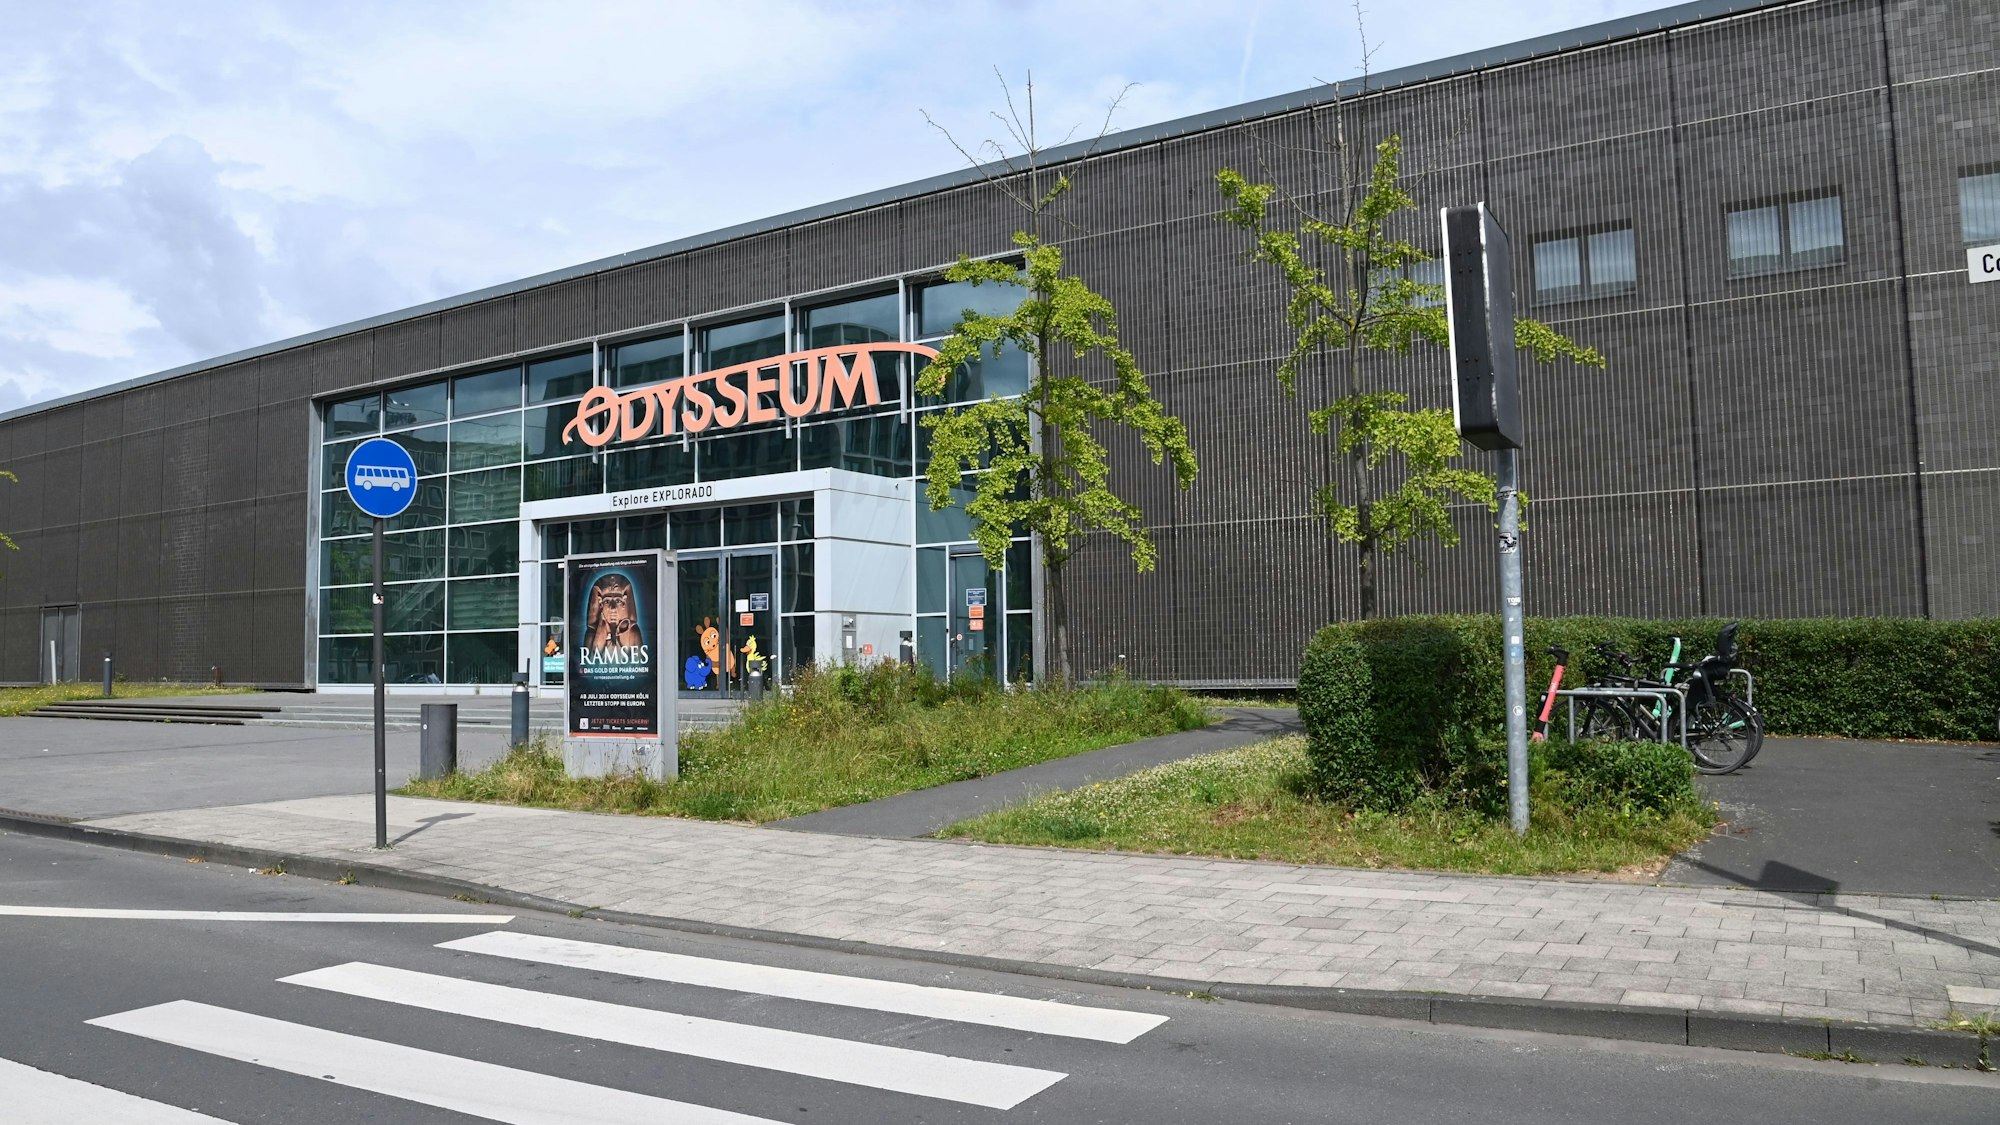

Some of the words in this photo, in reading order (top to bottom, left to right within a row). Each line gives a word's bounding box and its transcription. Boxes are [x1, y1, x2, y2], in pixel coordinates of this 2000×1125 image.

[563, 343, 938, 447] ODYSSEUM
[612, 494, 649, 509] Explore
[652, 485, 712, 502] EXPLORADO
[579, 645, 649, 665] RAMSES
